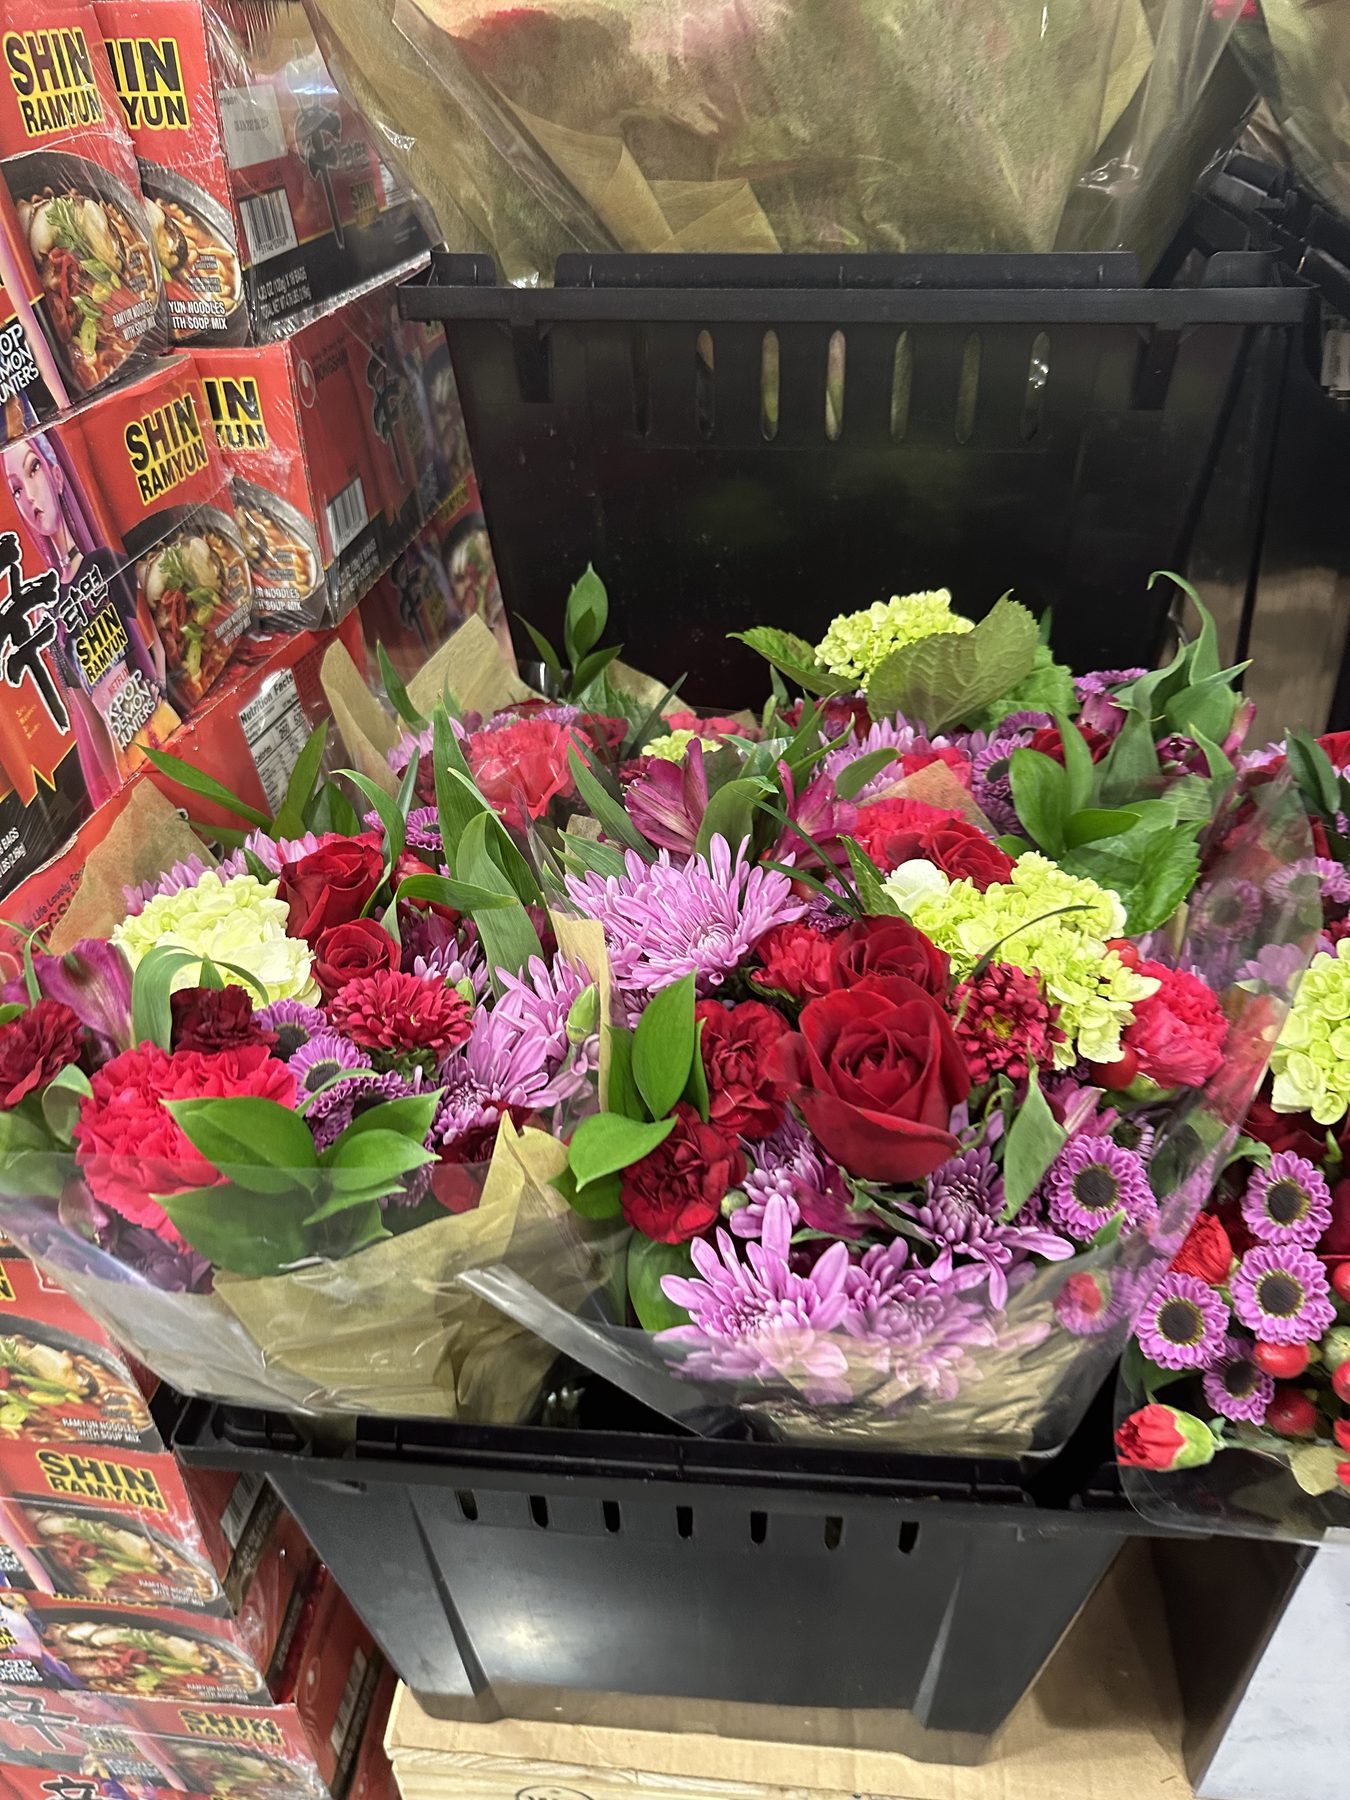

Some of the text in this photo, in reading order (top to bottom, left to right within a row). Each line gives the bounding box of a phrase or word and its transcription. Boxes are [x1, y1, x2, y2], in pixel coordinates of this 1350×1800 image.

[5, 30, 95, 96] SHIN
[105, 41, 182, 92] IN
[20, 88, 102, 134] RAMYUN
[119, 95, 188, 126] YUN
[168, 301, 226, 315] YUN NOODLES
[172, 316, 228, 330] ITH SOUP MIX
[0, 323, 23, 356] OP
[0, 340, 35, 382] MON
[0, 361, 39, 406] UNTERS
[204, 380, 261, 421] IN
[125, 395, 200, 472] SHIN
[137, 438, 208, 502] RAMYUN
[264, 588, 300, 599] NOODLES
[265, 601, 286, 611] SOUP
[75, 604, 121, 668] SHIN
[86, 628, 128, 686] RAMYUN
[104, 669, 143, 725] KPOP
[110, 679, 151, 738] DEMON
[240, 695, 273, 725] Nutrition
[273, 672, 294, 695] Facts
[115, 699, 156, 753] HUNTERS
[2, 827, 20, 850] BAGS
[33, 904, 49, 921] Life
[47, 880, 72, 907] Lovely
[62, 1417, 98, 1430] RAMYUN
[78, 1427, 141, 1443] WITH SOUP MIX
[37, 1451, 157, 1494] SHIN
[50, 1476, 166, 1511] RAMYUN
[179, 1710, 277, 1735] SHIN
